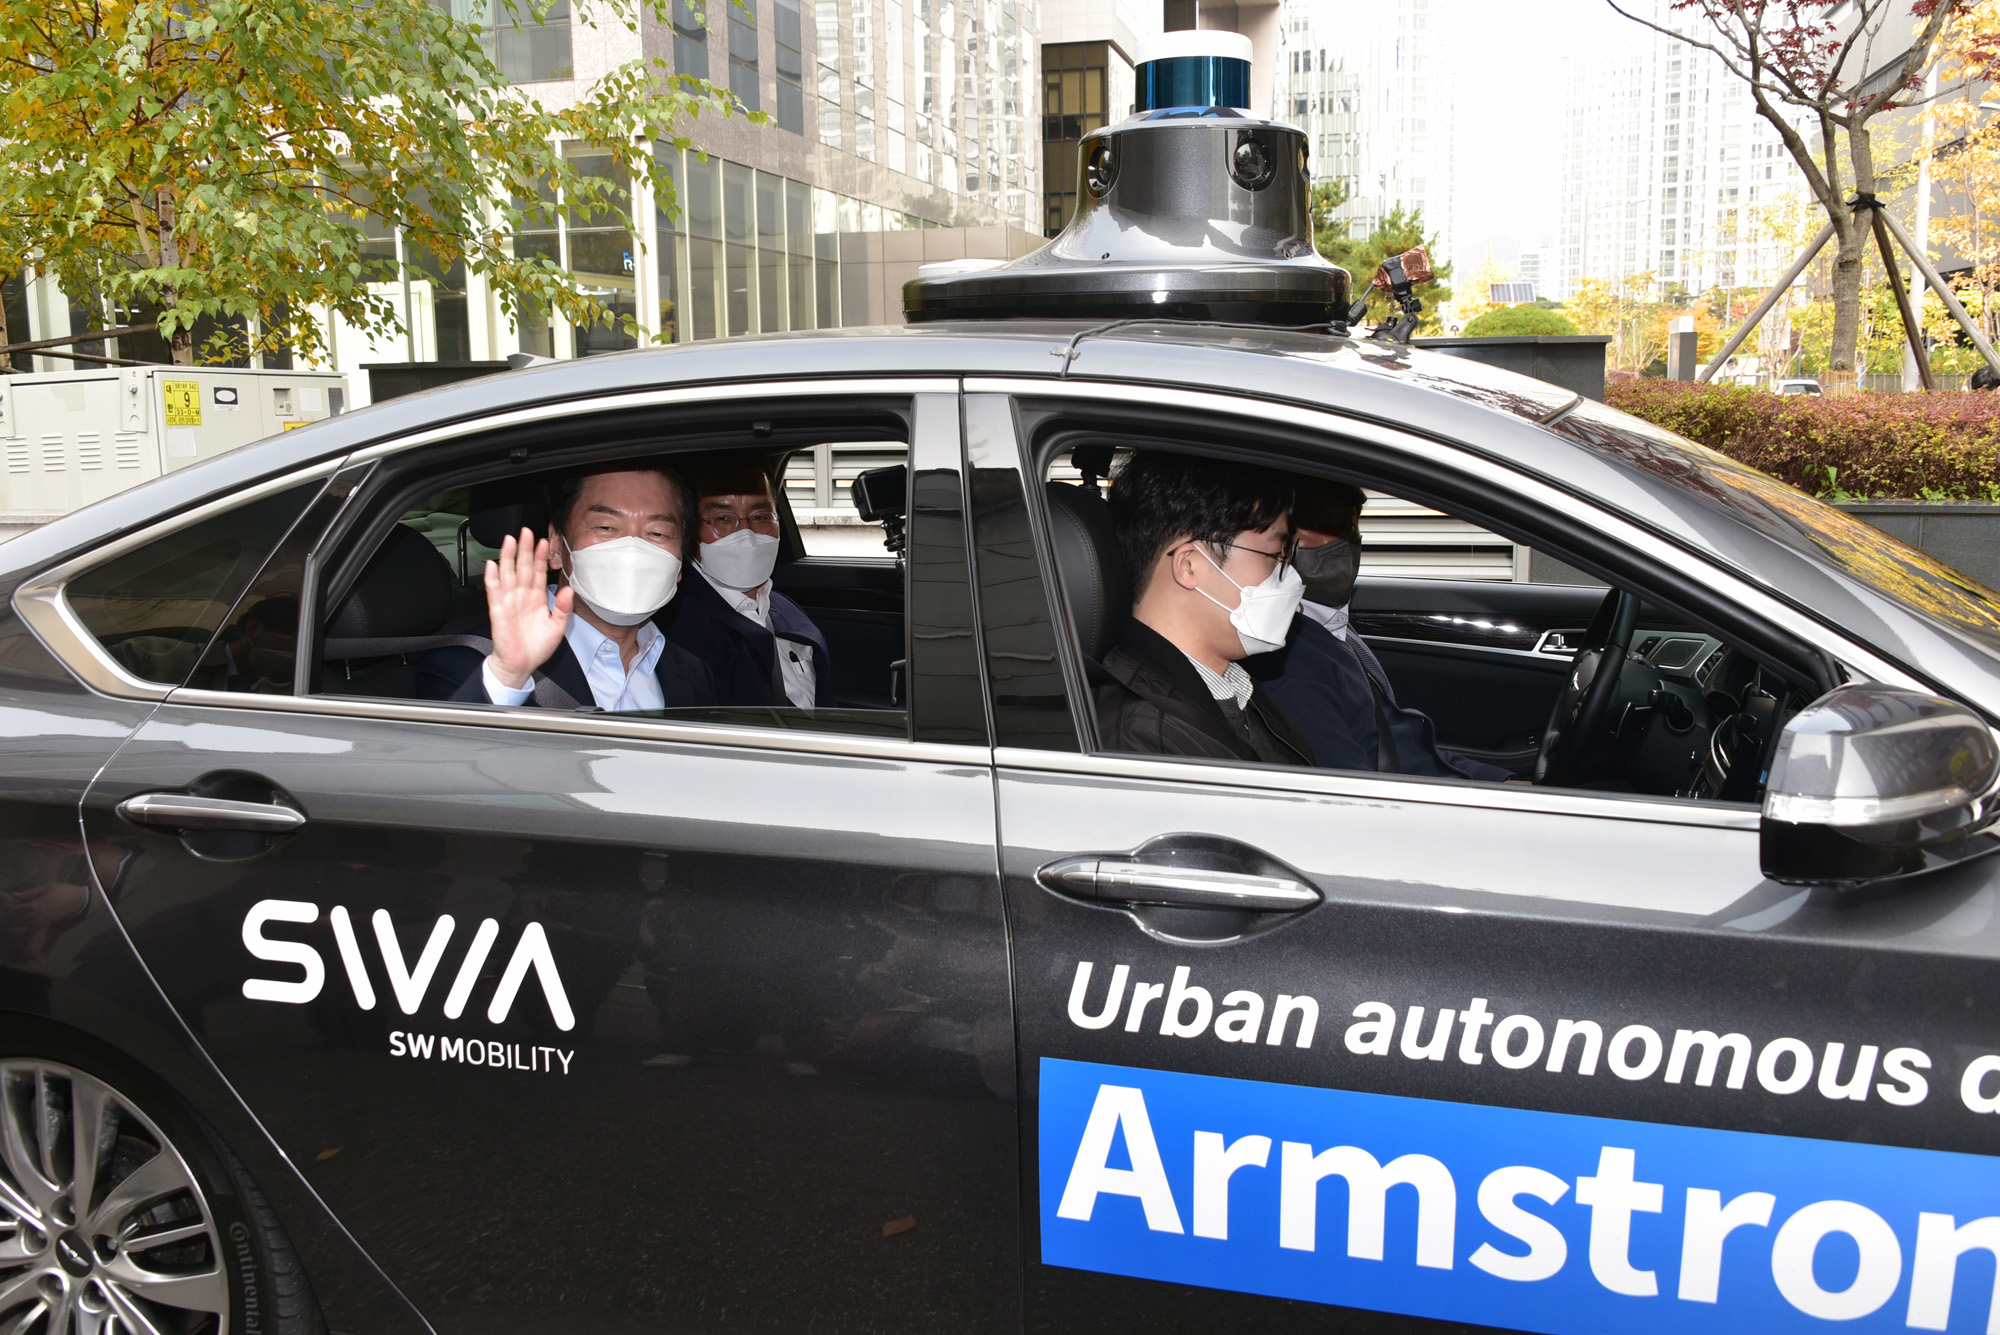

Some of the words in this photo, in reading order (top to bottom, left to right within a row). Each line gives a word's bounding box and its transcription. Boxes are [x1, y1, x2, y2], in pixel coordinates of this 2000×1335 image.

[184, 392, 191, 408] 9
[389, 1030, 436, 1060] SW
[440, 1036, 575, 1075] MOBILITY
[1067, 961, 1320, 1049] Urban
[1344, 997, 1932, 1106] autonomous
[1056, 1083, 2000, 1335] Armstron
